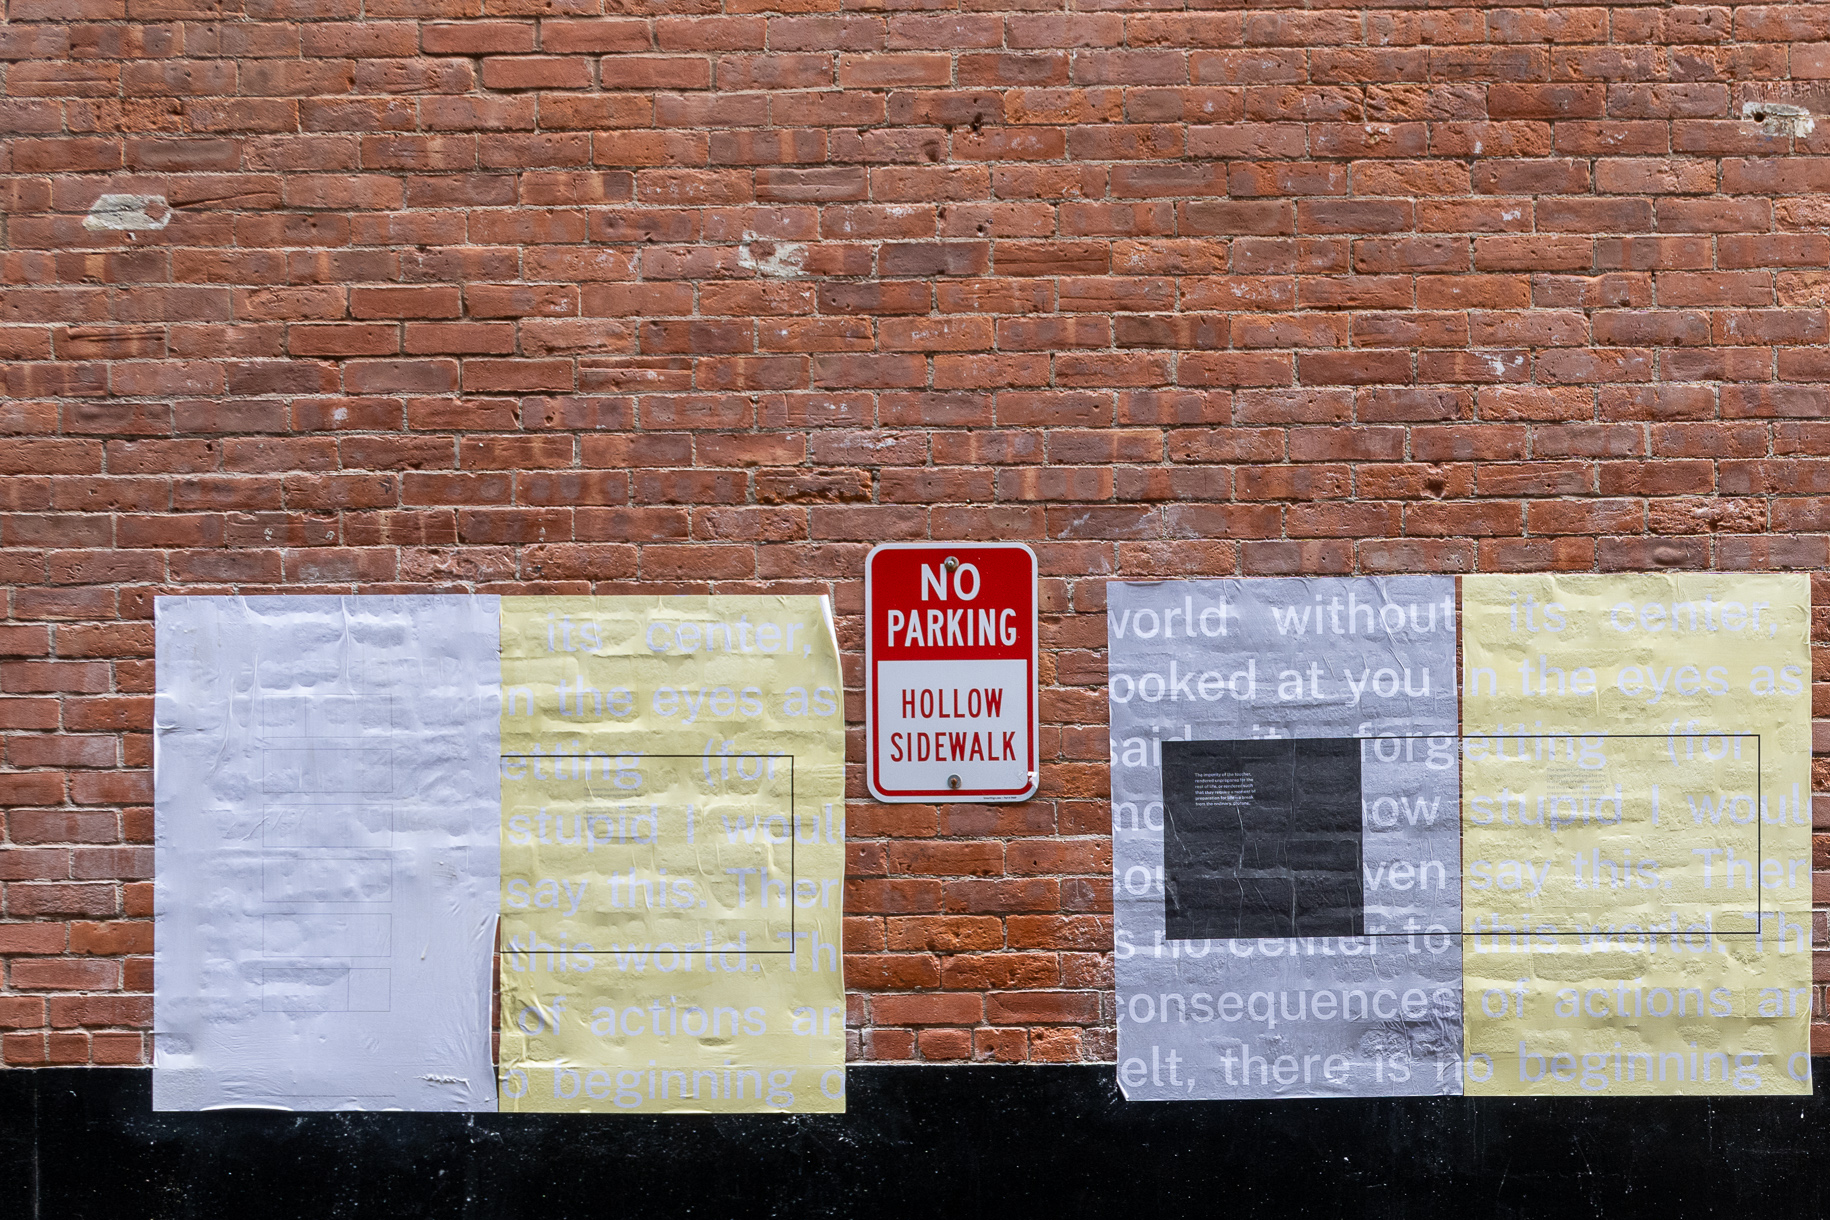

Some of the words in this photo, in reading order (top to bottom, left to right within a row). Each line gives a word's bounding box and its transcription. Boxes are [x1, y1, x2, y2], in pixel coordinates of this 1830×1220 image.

[921, 562, 981, 601] NO
[547, 612, 603, 652] its
[645, 614, 812, 659] center,
[888, 608, 1017, 647] PARKING
[1271, 592, 1464, 636] without
[1510, 590, 1567, 632] its
[1610, 594, 1778, 639] center,
[555, 675, 634, 717] the
[652, 684, 764, 725] eyes
[782, 684, 838, 717] as
[902, 688, 1003, 719] HOLLOW
[1277, 661, 1325, 701] at
[1344, 667, 1430, 707] you
[1518, 654, 1597, 697] the
[1616, 664, 1729, 705] eyes
[1749, 664, 1803, 697] as
[702, 738, 785, 787] (for
[891, 731, 1016, 762] SIDEWALK
[1667, 718, 1750, 767] (for
[508, 802, 658, 853] stupid
[721, 803, 846, 845] woul
[1470, 782, 1622, 834] stupid
[1687, 782, 1812, 826] woul
[506, 876, 588, 917] say
[607, 867, 707, 909] this.
[726, 867, 839, 909] Ther
[1469, 857, 1550, 898] say
[1571, 848, 1672, 890] this.
[1692, 848, 1812, 890] Ther
[508, 931, 596, 973] this
[612, 930, 761, 973] world.
[777, 930, 837, 972] Th
[1403, 917, 1451, 955] to
[1470, 912, 1558, 954] this
[1576, 912, 1726, 954] world.
[1743, 911, 1812, 954] Th
[518, 995, 566, 1037] of
[590, 995, 767, 1037] actions
[792, 1006, 846, 1037] ar
[1481, 977, 1531, 1018] of
[1554, 977, 1733, 1018] actions
[1758, 986, 1812, 1018] ar
[553, 1058, 797, 1108] beginning
[1220, 1043, 1350, 1087] there
[1375, 1047, 1411, 1083] is
[1436, 1050, 1494, 1083] no
[1519, 1041, 1763, 1092] beginning
